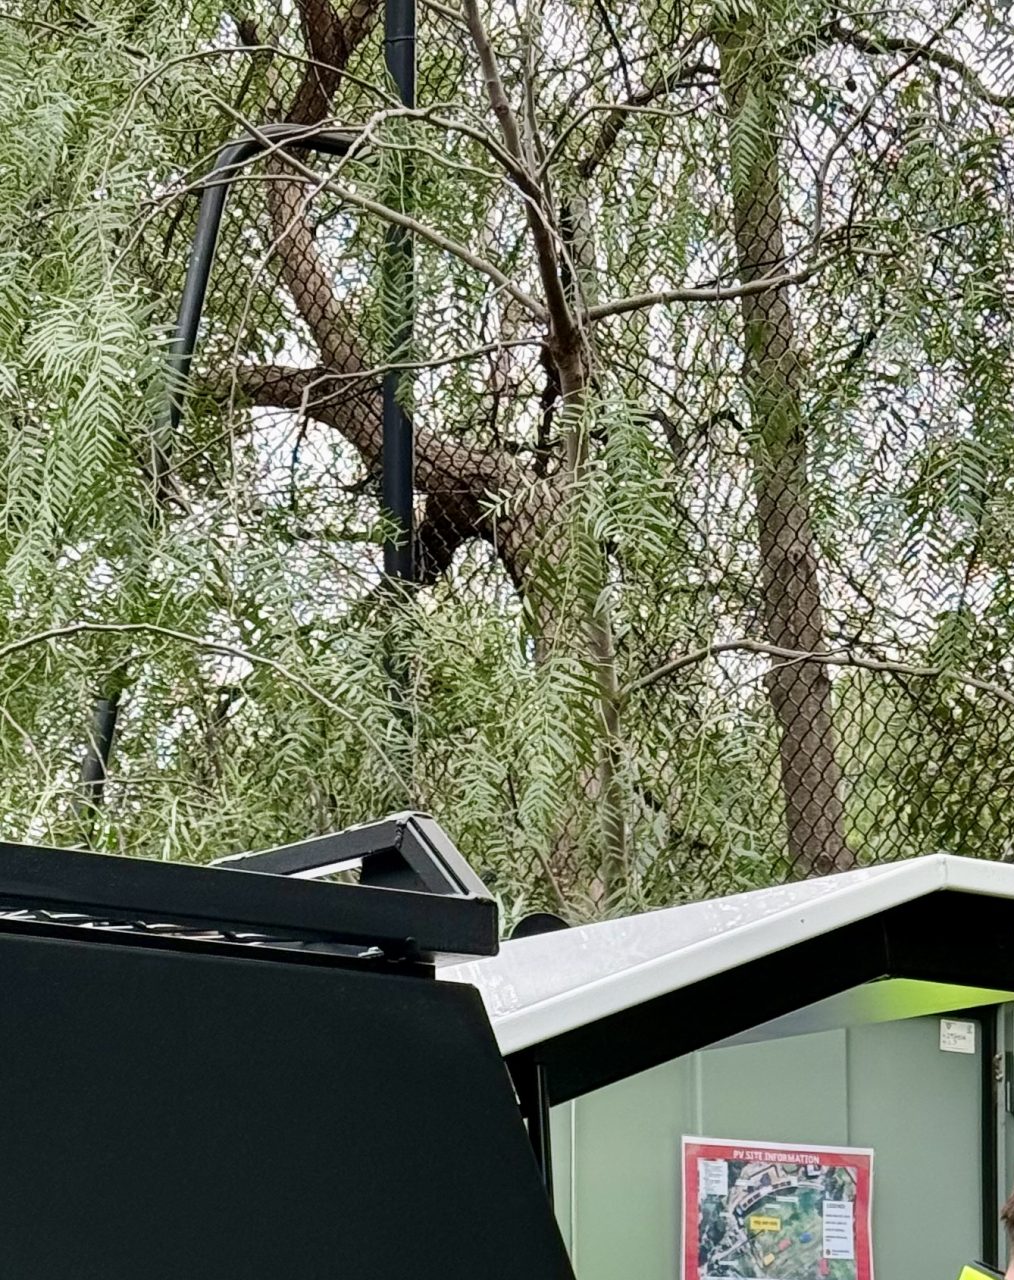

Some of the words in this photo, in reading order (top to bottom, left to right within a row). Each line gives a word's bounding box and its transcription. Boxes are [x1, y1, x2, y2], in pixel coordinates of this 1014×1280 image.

[733, 1149, 744, 1159] PV
[745, 1151, 763, 1161] SITE
[764, 1152, 820, 1164] INFORMATION
